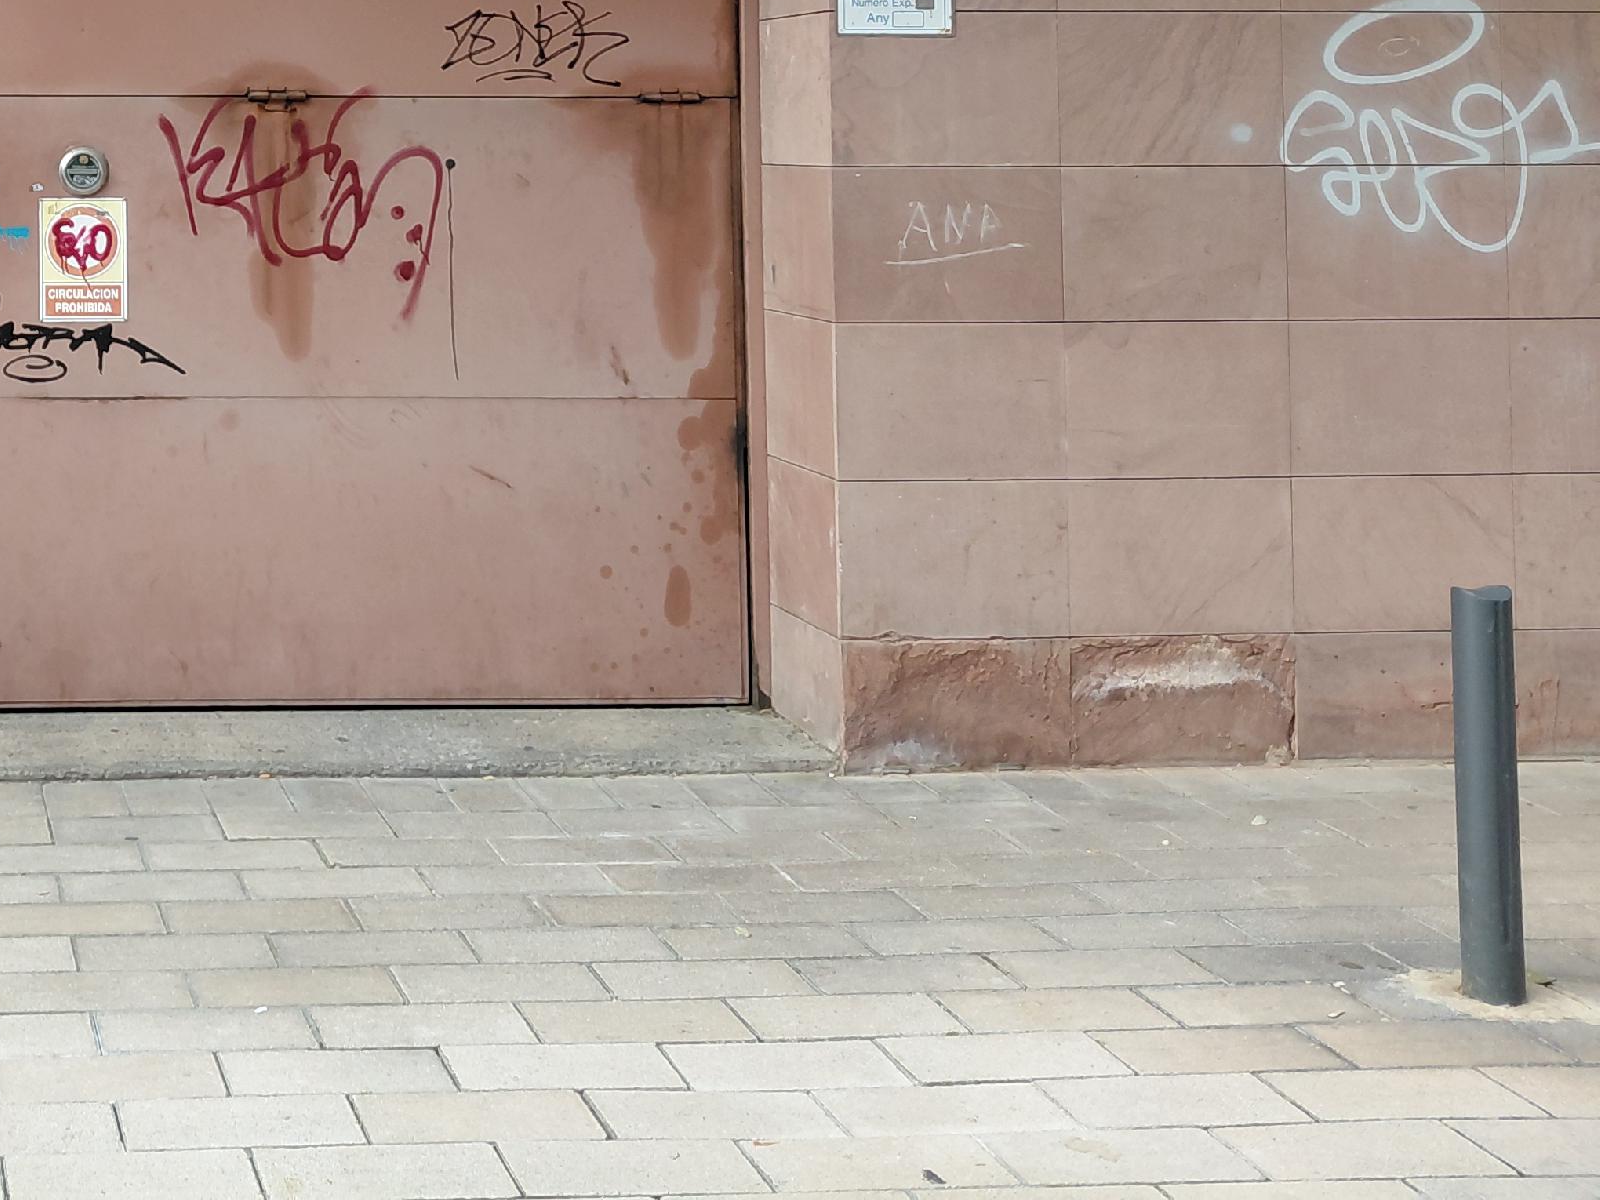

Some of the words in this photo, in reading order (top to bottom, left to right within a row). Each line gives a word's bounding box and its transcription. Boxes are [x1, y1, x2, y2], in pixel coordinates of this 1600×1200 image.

[866, 12, 890, 26] Any
[48, 288, 119, 300] CIRCULACION
[55, 301, 113, 314] PROHIBIDA
